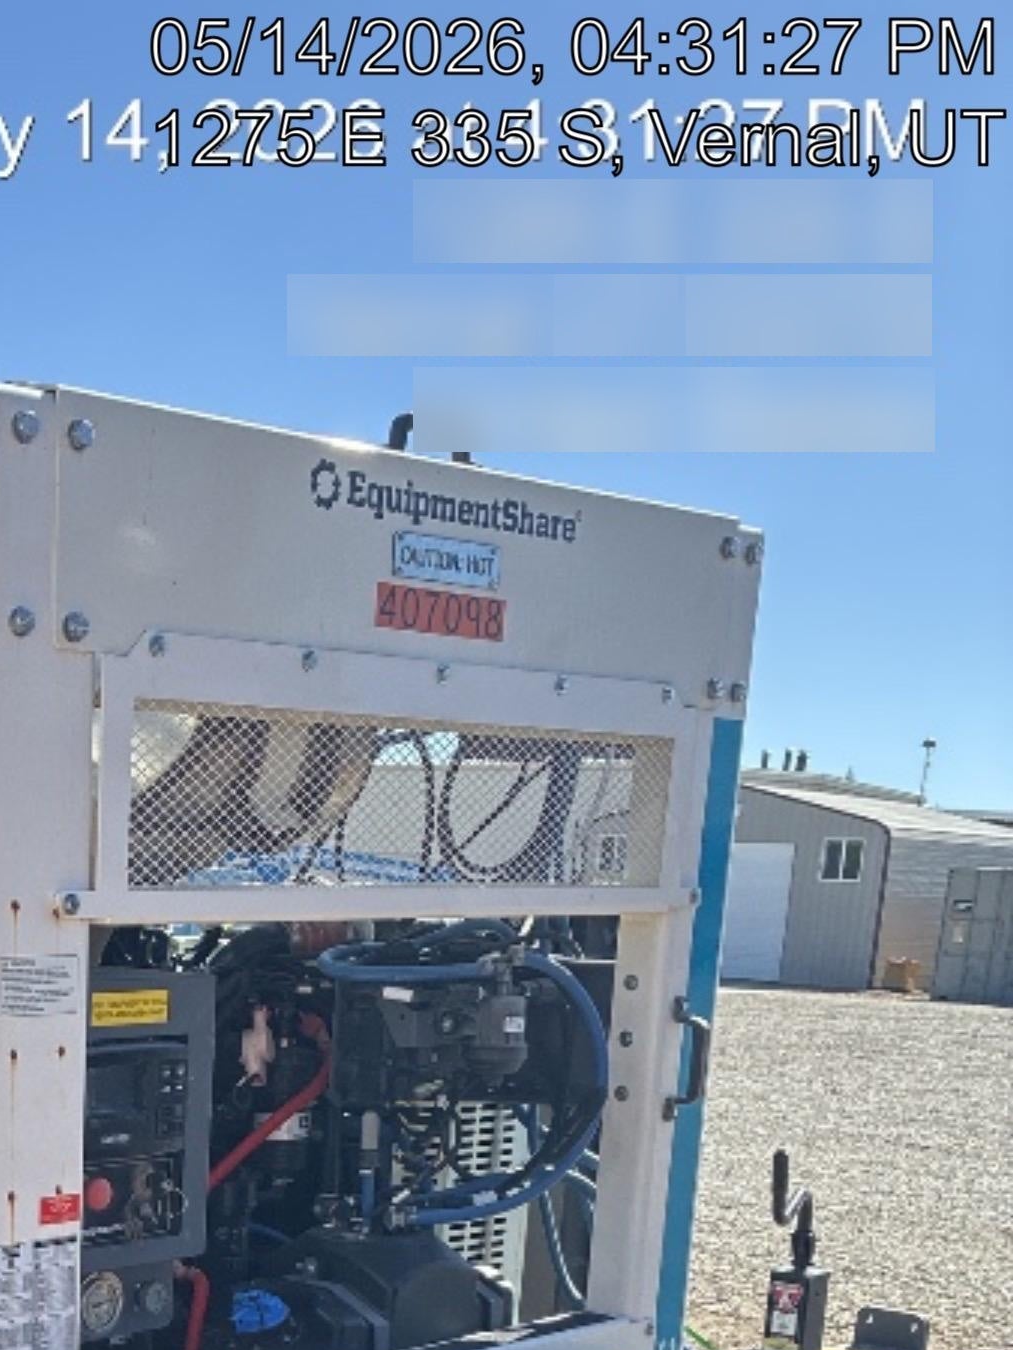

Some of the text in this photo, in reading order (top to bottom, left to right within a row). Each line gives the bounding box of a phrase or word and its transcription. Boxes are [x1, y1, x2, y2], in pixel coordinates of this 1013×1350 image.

[346, 470, 577, 543] EquipmentShare
[466, 554, 496, 577] HOT
[378, 585, 502, 638] 407098
